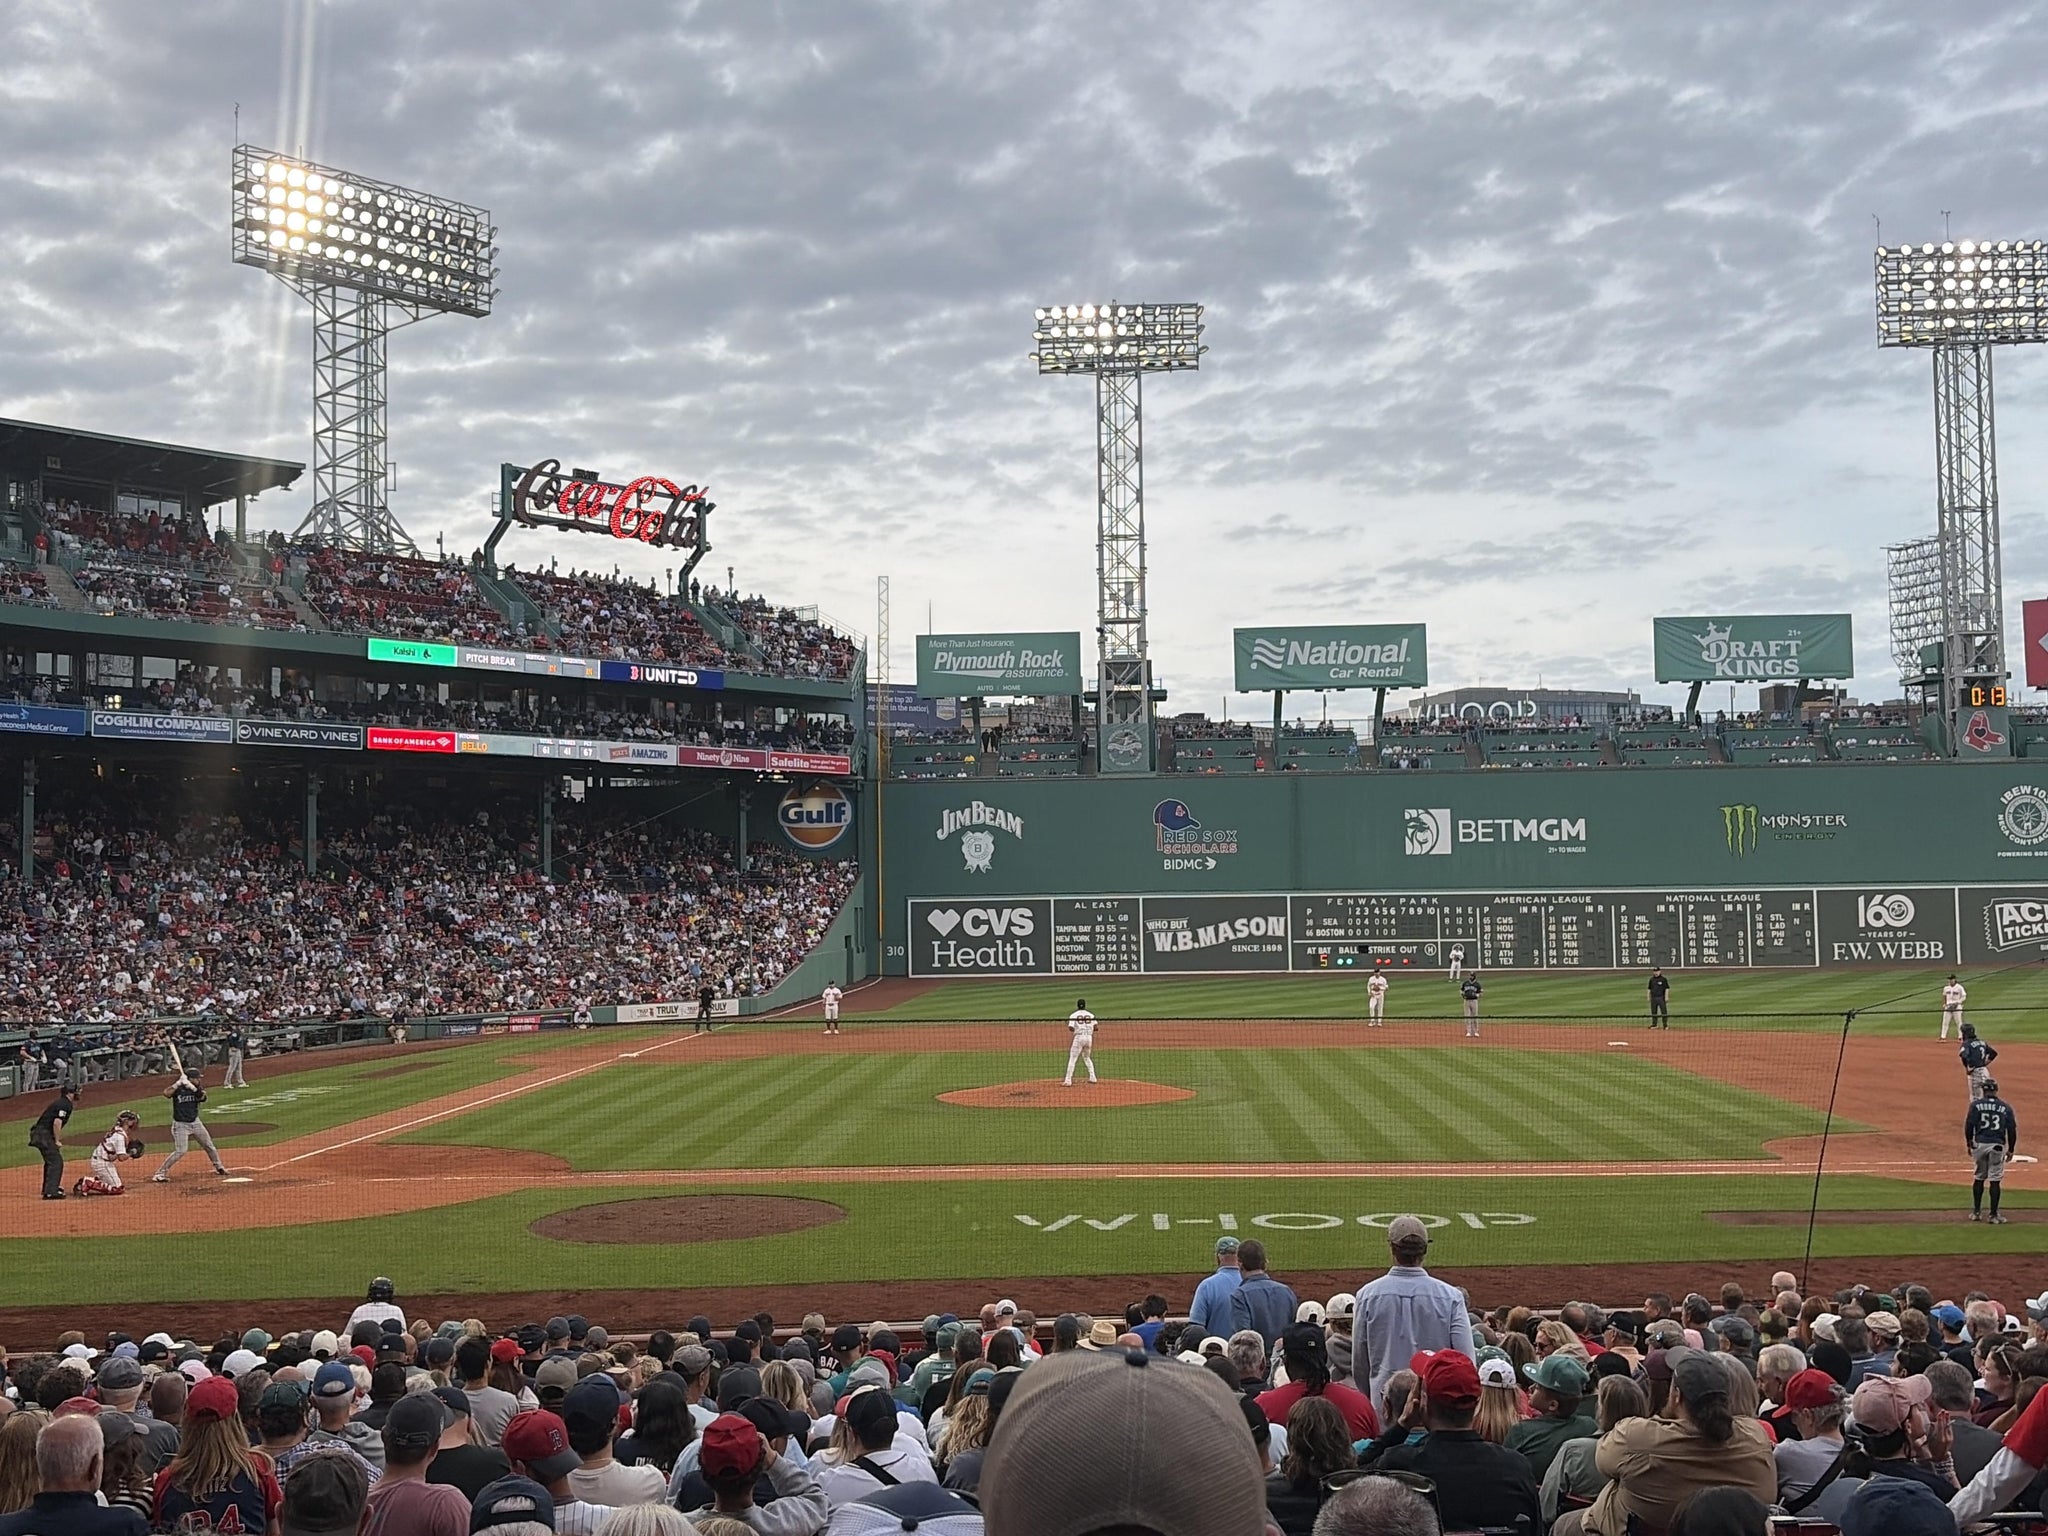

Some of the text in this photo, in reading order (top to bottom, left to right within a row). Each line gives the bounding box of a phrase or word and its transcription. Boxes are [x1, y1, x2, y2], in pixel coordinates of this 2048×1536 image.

[928, 639, 1015, 648] More Than Just Insurance.
[1702, 640, 1801, 662] DRAFT
[394, 647, 416, 656] Kalshi
[1287, 638, 1407, 666] National
[466, 654, 516, 666] PITCH BREAK
[934, 650, 1062, 671] Plymouth Rock
[1715, 658, 1799, 676] KINGS
[646, 667, 698, 684] UNITED
[1005, 668, 1064, 678] assurance
[1330, 666, 1403, 678] Car Rental
[894, 696, 904, 705] top
[1971, 686, 2005, 706] 0:13
[1410, 699, 1536, 721] WHOOP
[26, 722, 48, 730] Medical
[50, 724, 69, 732] Center
[94, 714, 230, 731] COGHLIN COMPANIES
[252, 727, 358, 742] VINEYARD VINES
[461, 742, 488, 752] BELLO
[631, 749, 668, 759] AMAZING
[697, 752, 750, 763] Ninety Nine
[771, 756, 809, 768] Safelite
[2000, 785, 2032, 804] IBEW
[781, 802, 848, 824] Gulf
[936, 800, 1024, 840] JIM BEAM
[1761, 813, 1848, 828] MONSTER
[1458, 818, 1586, 842] BETMGM
[1998, 814, 2010, 836] NECA
[1164, 830, 1237, 842] RED SOX
[1164, 843, 1237, 854] SCHOLARS
[1164, 859, 1202, 870] BIDMC
[1858, 894, 1915, 928] 160
[962, 908, 1034, 938] CVS
[1146, 920, 1188, 930] WHO BUT
[887, 946, 904, 956] 310
[931, 940, 1035, 968] Health
[1832, 942, 1944, 960] F.W. WEBB
[656, 1006, 678, 1014] TRULY
[710, 1002, 727, 1011] RULY
[1980, 1113, 2000, 1130] 53
[1013, 1212, 1538, 1231] WHOOP
[821, 1356, 839, 1370] BAT
